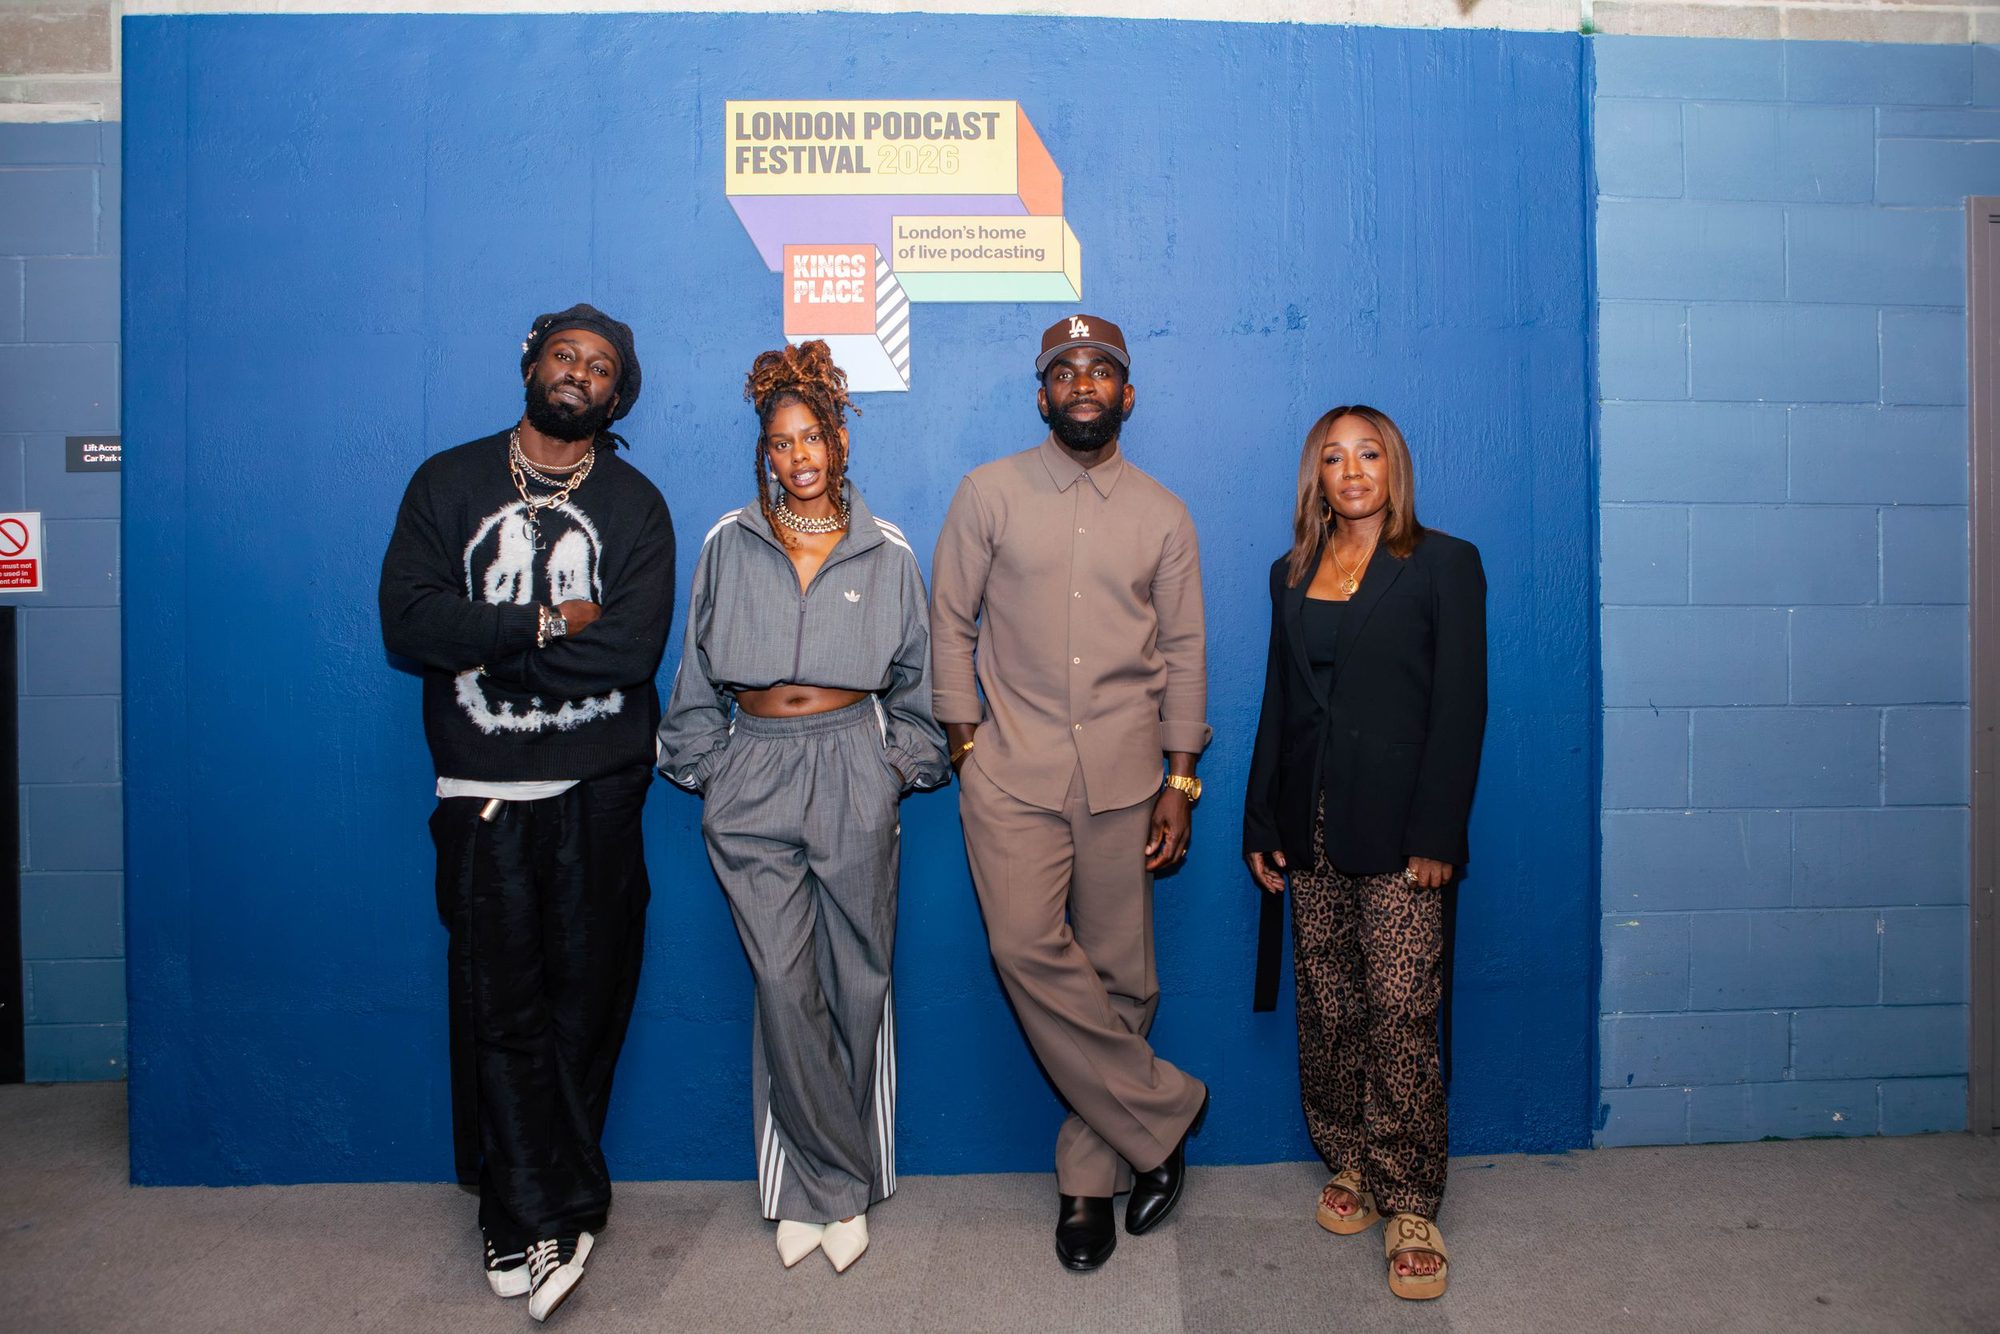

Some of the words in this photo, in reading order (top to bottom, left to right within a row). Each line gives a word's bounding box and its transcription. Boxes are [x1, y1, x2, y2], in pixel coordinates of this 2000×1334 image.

[735, 111, 856, 141] LONDON
[863, 111, 1000, 140] PODCAST
[735, 145, 871, 174] FESTIVAL
[877, 144, 960, 175] 2026
[898, 225, 976, 240] London’s
[978, 225, 1027, 239] home
[898, 245, 916, 259] of
[918, 244, 948, 259] live
[950, 244, 1046, 262] podcasting
[793, 254, 866, 278] KINGS
[793, 280, 865, 304] PLACE
[1069, 316, 1090, 338] LA
[84, 454, 98, 462] Car
[99, 454, 117, 462] Park
